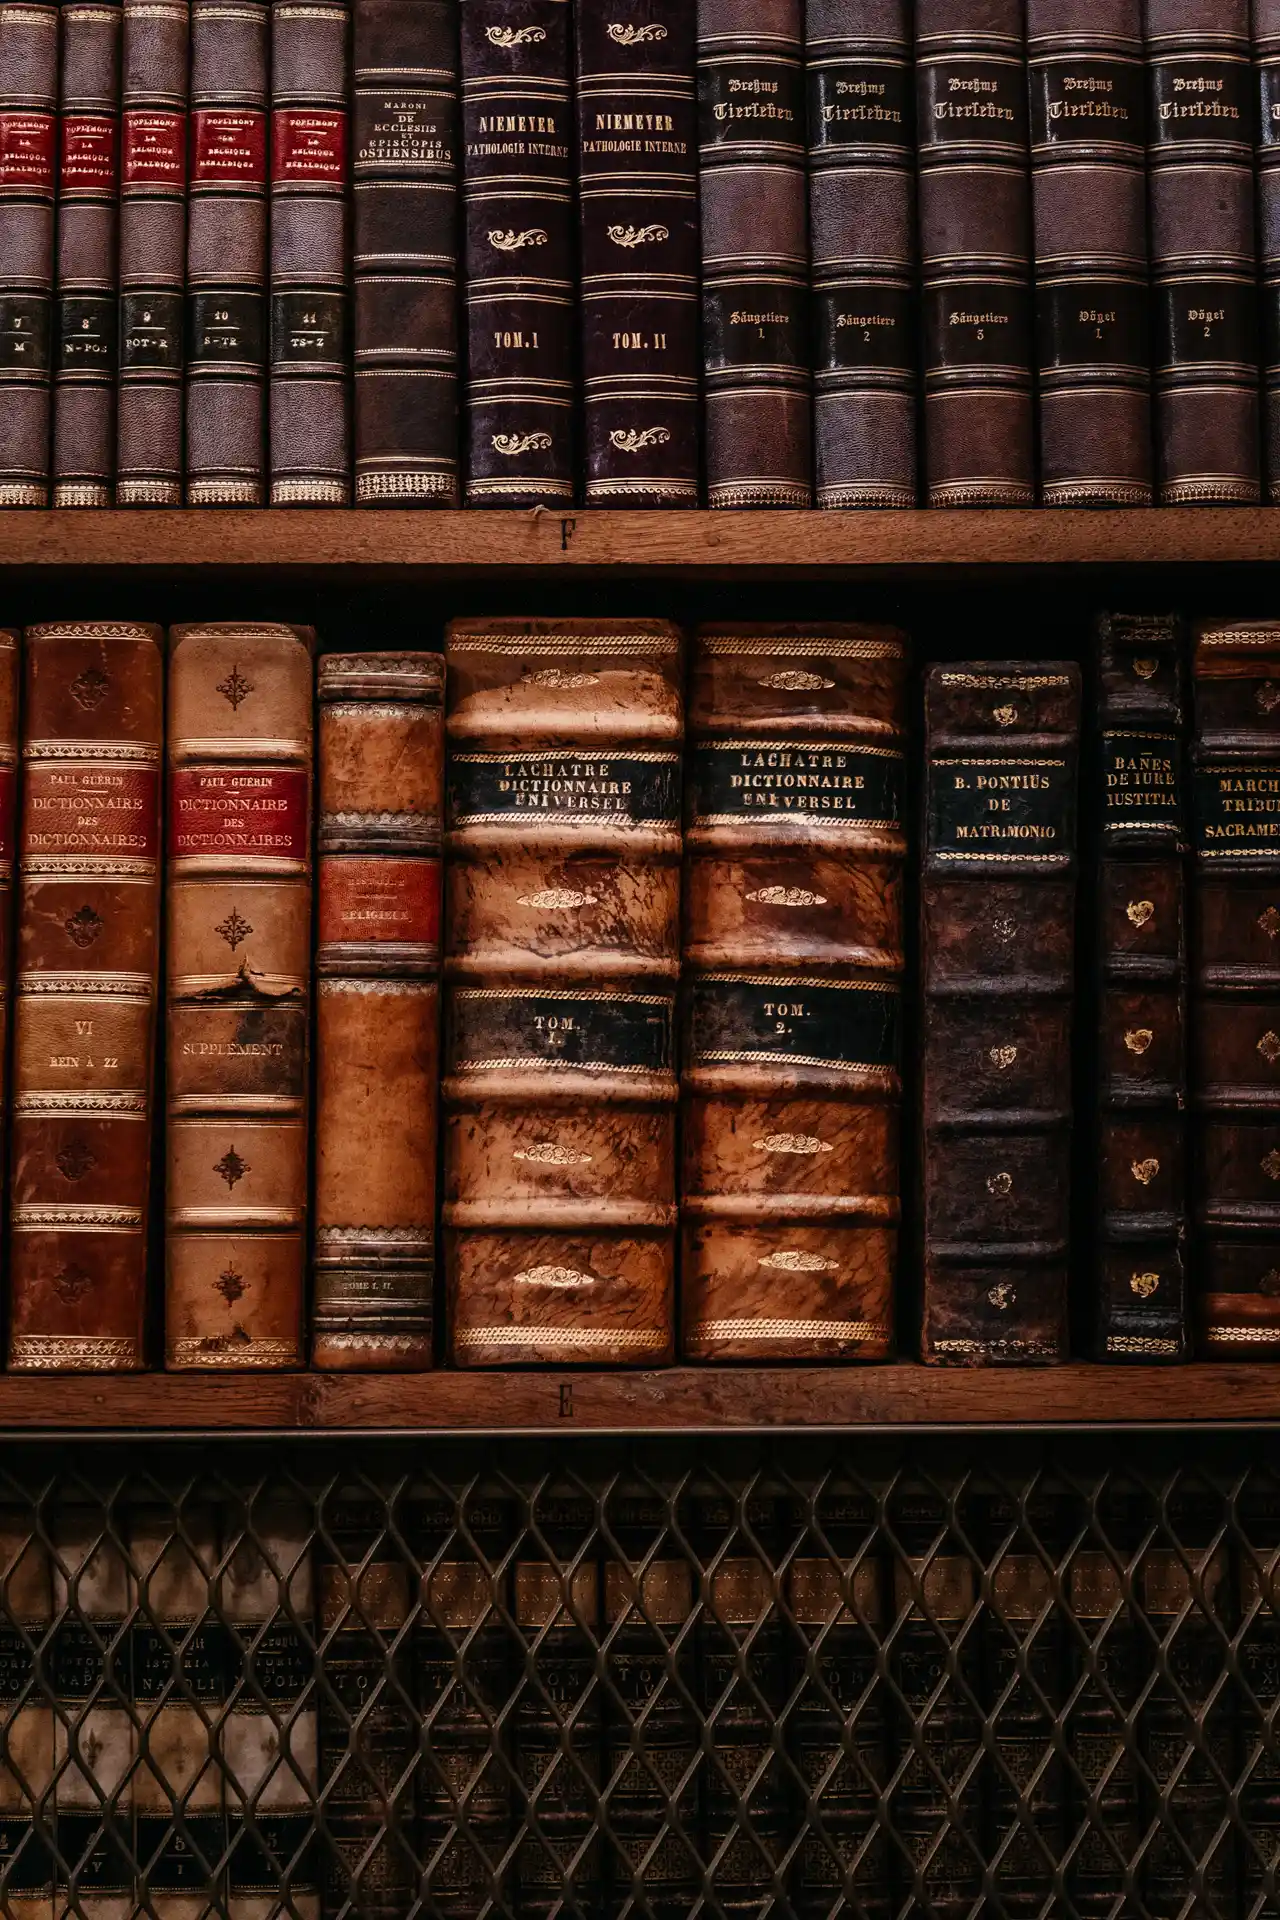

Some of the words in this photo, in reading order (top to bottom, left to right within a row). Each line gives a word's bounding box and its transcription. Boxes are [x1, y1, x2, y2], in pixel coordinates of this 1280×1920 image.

[728, 79, 780, 94] Brehms
[835, 80, 886, 96] Brehms
[948, 78, 998, 93] Brehms
[1063, 77, 1113, 92] Brehms
[1172, 77, 1224, 92] Brehms
[384, 101, 427, 110] MARONI
[713, 101, 794, 121] Tierleben
[935, 101, 1014, 120] Tierleben
[1049, 100, 1129, 119] Tierleben
[1159, 100, 1240, 120] Tierleben
[398, 115, 415, 123] DE
[821, 104, 902, 122] Tierleben
[374, 123, 437, 133] ECCLESIIS
[478, 115, 557, 133] NIEMEYER
[595, 113, 674, 131] NIEMEYER
[369, 140, 442, 149] EPISCOPIS
[466, 142, 525, 157] PATHOLOGIE
[527, 142, 569, 158] INTERNE
[582, 140, 641, 153] PATHOLOGIE
[644, 140, 687, 154] INTERNE
[359, 148, 452, 160] OSTIENSIBUS
[143, 311, 151, 322] 9
[214, 310, 229, 320] 10
[303, 312, 317, 324] 11
[730, 311, 790, 324] Säugetiere
[836, 313, 896, 328] Säugetiere
[949, 311, 1009, 325] Säugetiere
[14, 318, 22, 328] 7
[81, 318, 90, 329] 8
[863, 331, 871, 342] 2
[976, 329, 984, 341] 3
[1203, 326, 1211, 338] 2
[14, 342, 25, 351] M
[612, 332, 648, 349] TOM.
[560, 518, 577, 551] F
[741, 754, 848, 768] LACHATRE
[504, 763, 609, 777] LACHATRE
[51, 774, 78, 787] PAUL
[200, 776, 226, 788] PAUL
[731, 774, 865, 789] DICTIONNAIRE
[953, 776, 971, 790] B.
[976, 774, 1051, 790] PONTIUS
[1105, 772, 1129, 787] DE
[1133, 771, 1176, 786] IURE
[498, 779, 633, 795] DICTIONNAIRE
[31, 797, 143, 811] DICTIONNAIRE
[179, 799, 288, 811] DICTIONNAIRE
[515, 792, 627, 811] UNIVERSEL
[742, 792, 856, 810] UNIVERSEL
[987, 798, 1011, 812] DE
[1106, 792, 1178, 806] IUSTITIA
[78, 815, 98, 827] DES
[223, 817, 244, 829] DES
[955, 824, 1057, 840] MATRIMONIO
[1203, 823, 1280, 839] SACRAME
[28, 833, 146, 848] DICTIONNAIRES
[177, 833, 292, 847] DICTIONNAIRES
[763, 1002, 811, 1017] TOM.
[74, 1020, 94, 1036] VI
[533, 1015, 581, 1030] TOM.
[775, 1020, 793, 1034] 2.
[183, 1042, 284, 1057] SUPPLEMENT
